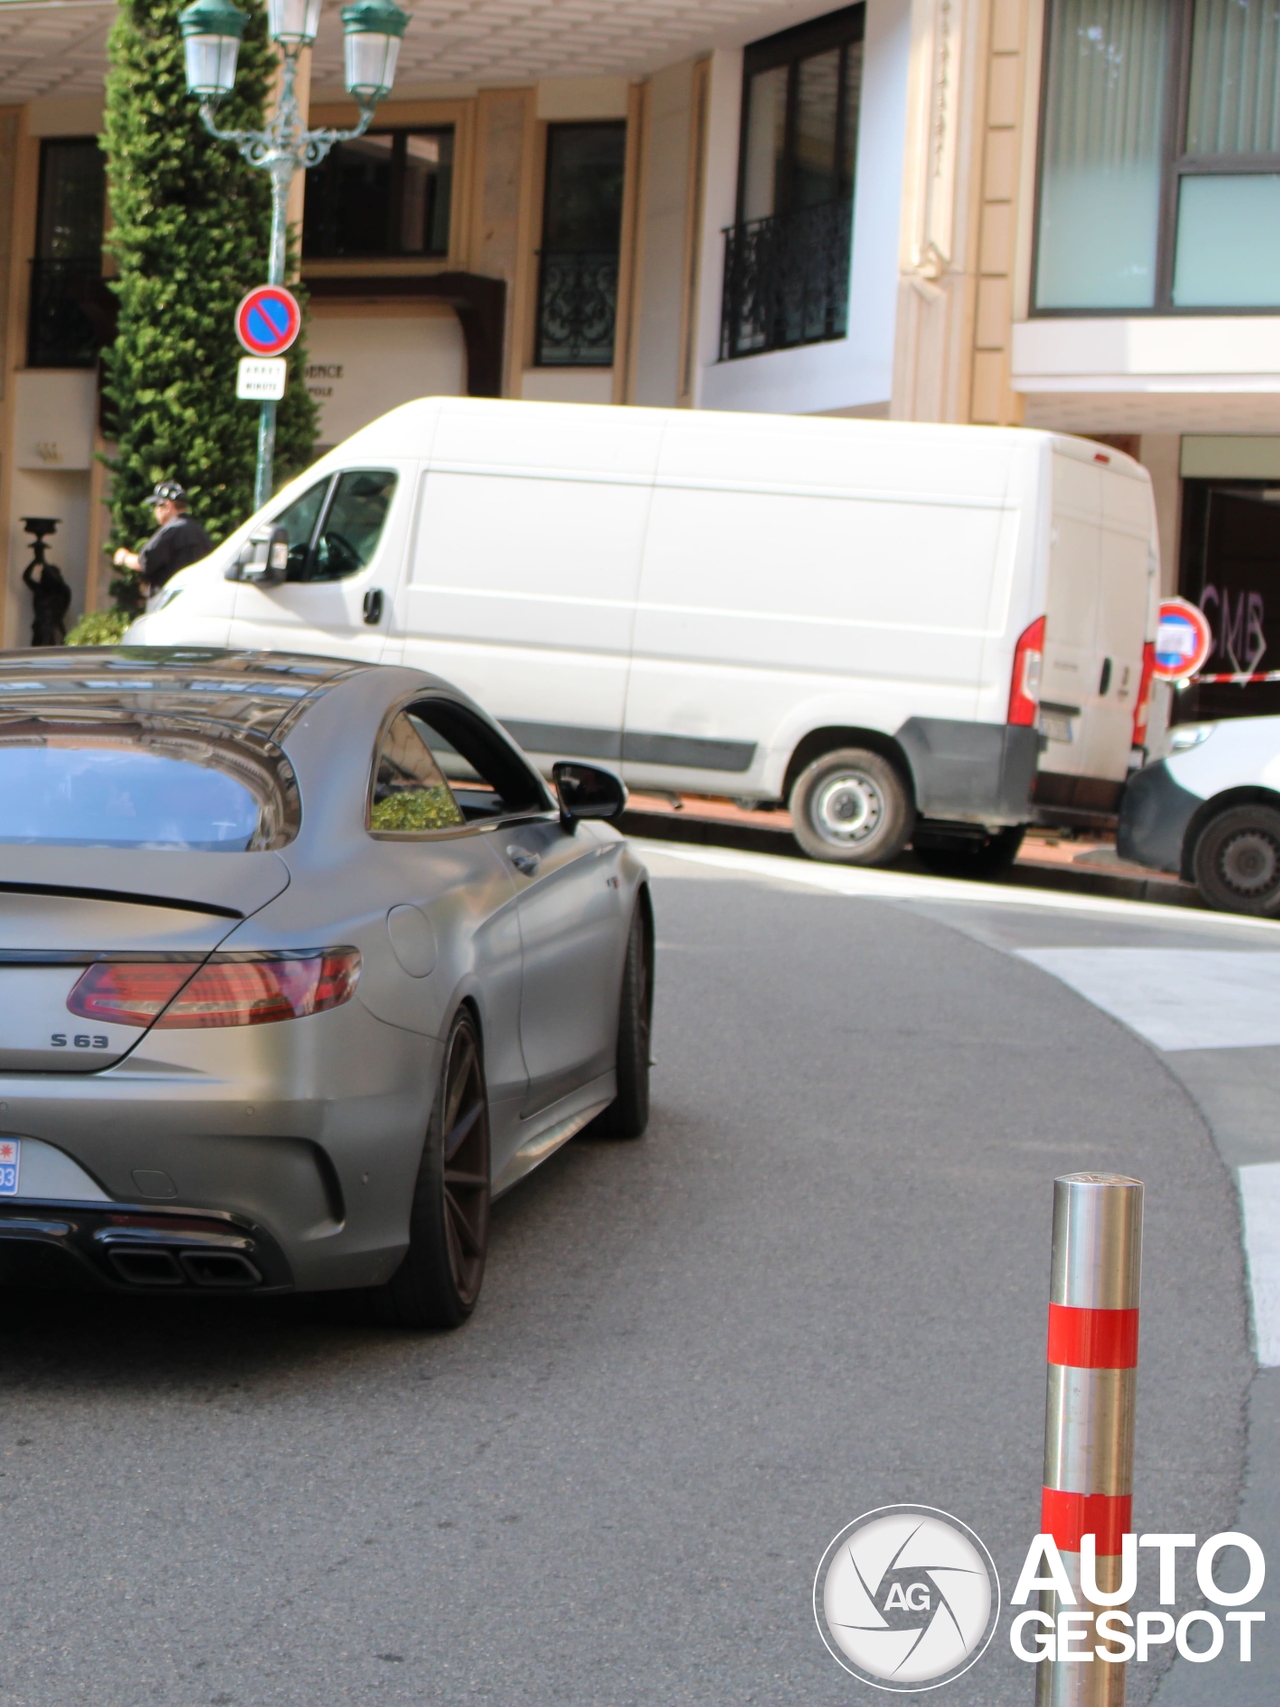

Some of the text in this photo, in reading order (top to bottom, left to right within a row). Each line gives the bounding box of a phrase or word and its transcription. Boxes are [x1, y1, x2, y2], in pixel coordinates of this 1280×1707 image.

[245, 381, 277, 391] MINUTE
[51, 1034, 108, 1049] S 63
